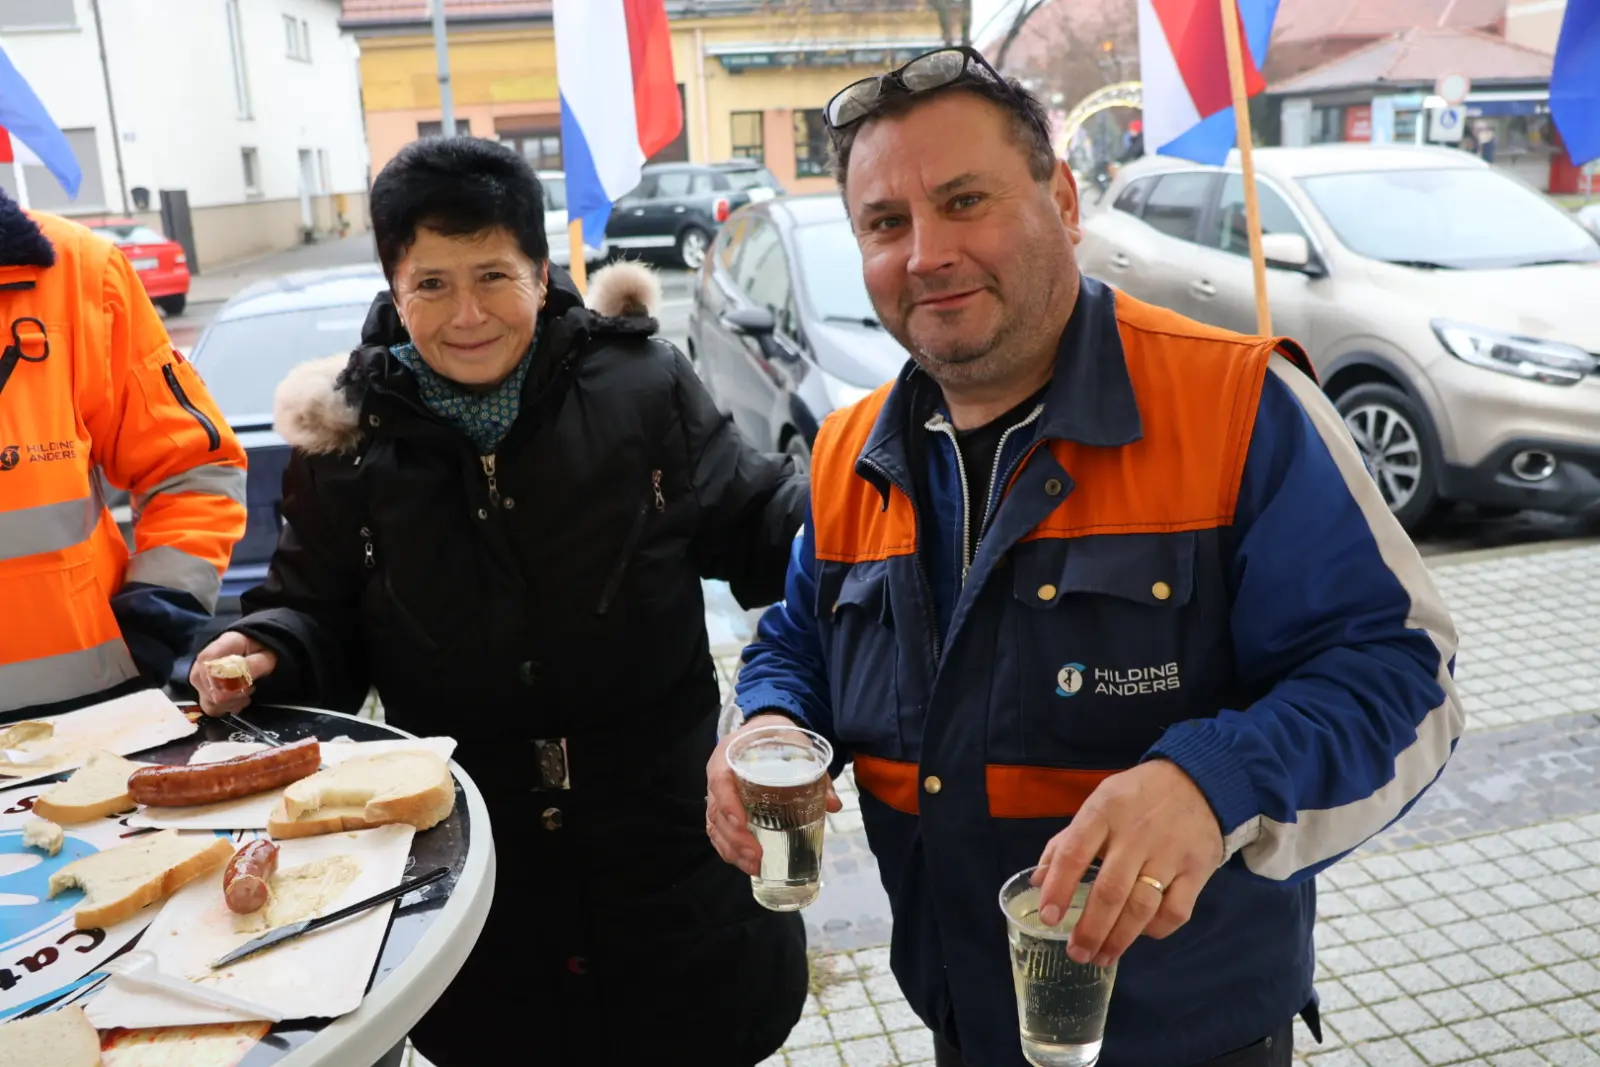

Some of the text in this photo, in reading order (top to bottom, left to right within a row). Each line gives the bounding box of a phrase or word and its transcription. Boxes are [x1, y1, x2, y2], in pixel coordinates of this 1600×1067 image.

[29, 450, 77, 462] ANDERS
[1094, 662, 1179, 683] HILDING
[1094, 676, 1180, 696] ANDERS
